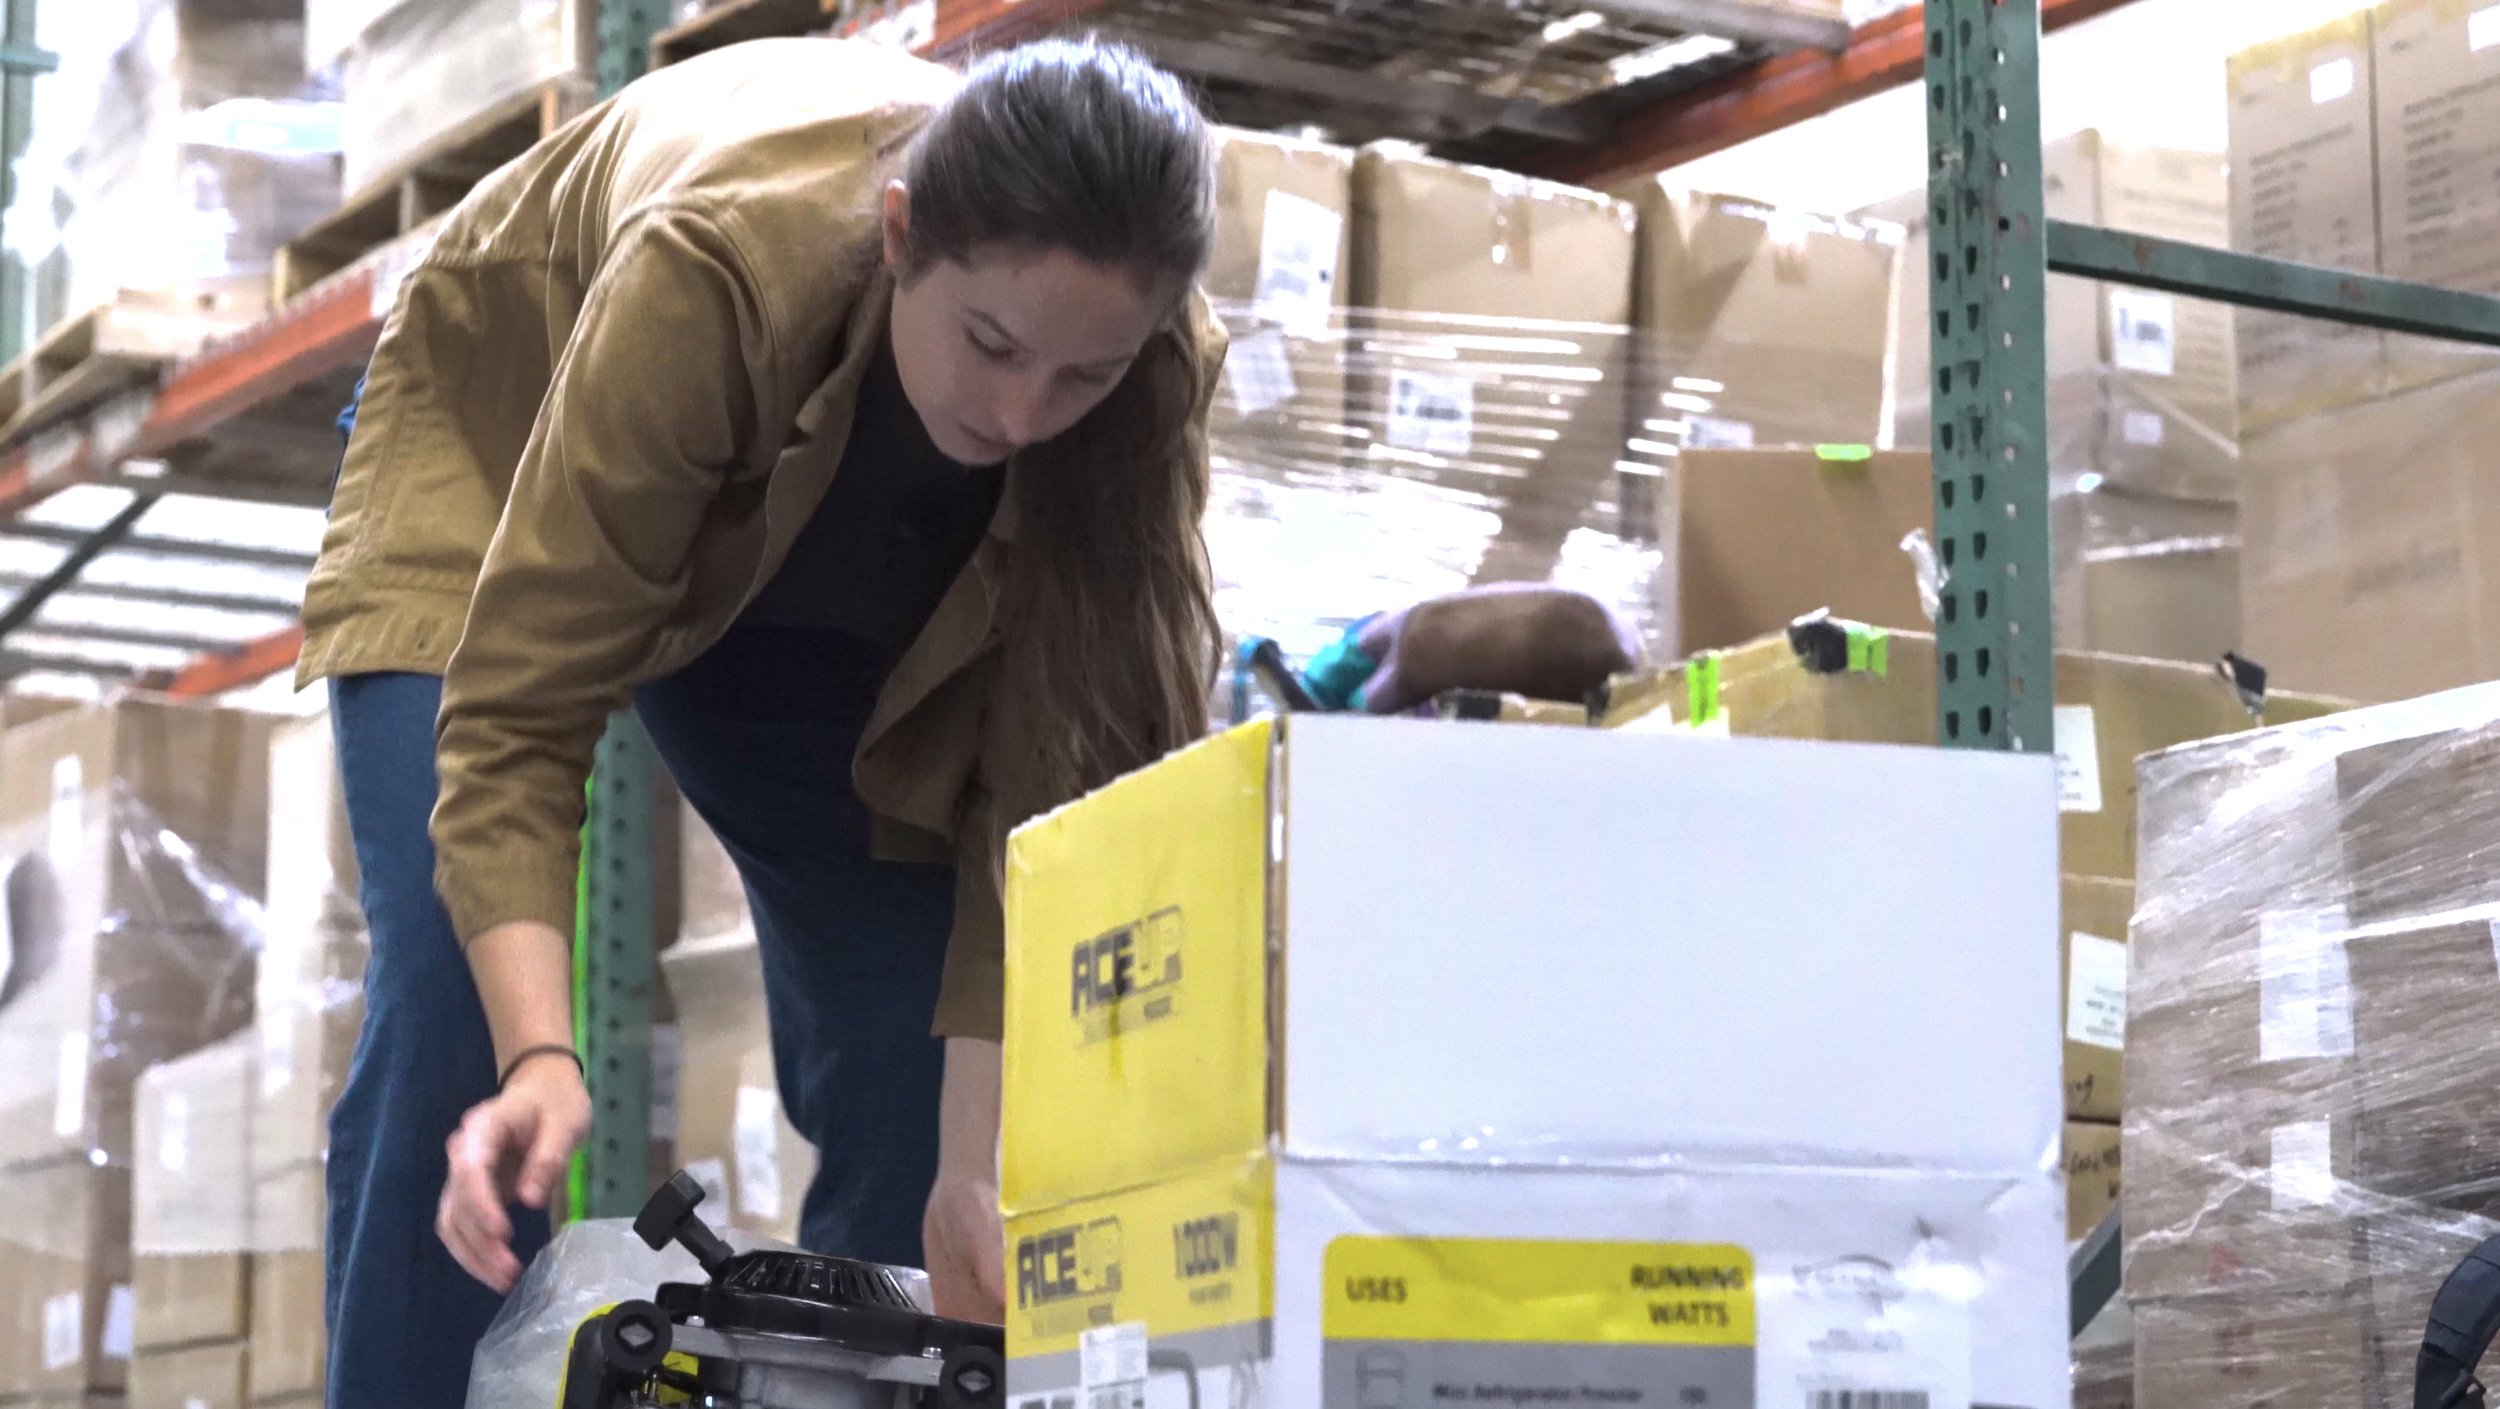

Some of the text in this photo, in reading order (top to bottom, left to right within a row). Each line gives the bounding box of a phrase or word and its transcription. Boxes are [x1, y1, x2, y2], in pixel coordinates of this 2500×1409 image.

[1345, 1275, 1407, 1304] USES
[1631, 1264, 1744, 1290] RUNNING
[1648, 1302, 1729, 1327] WATTS
